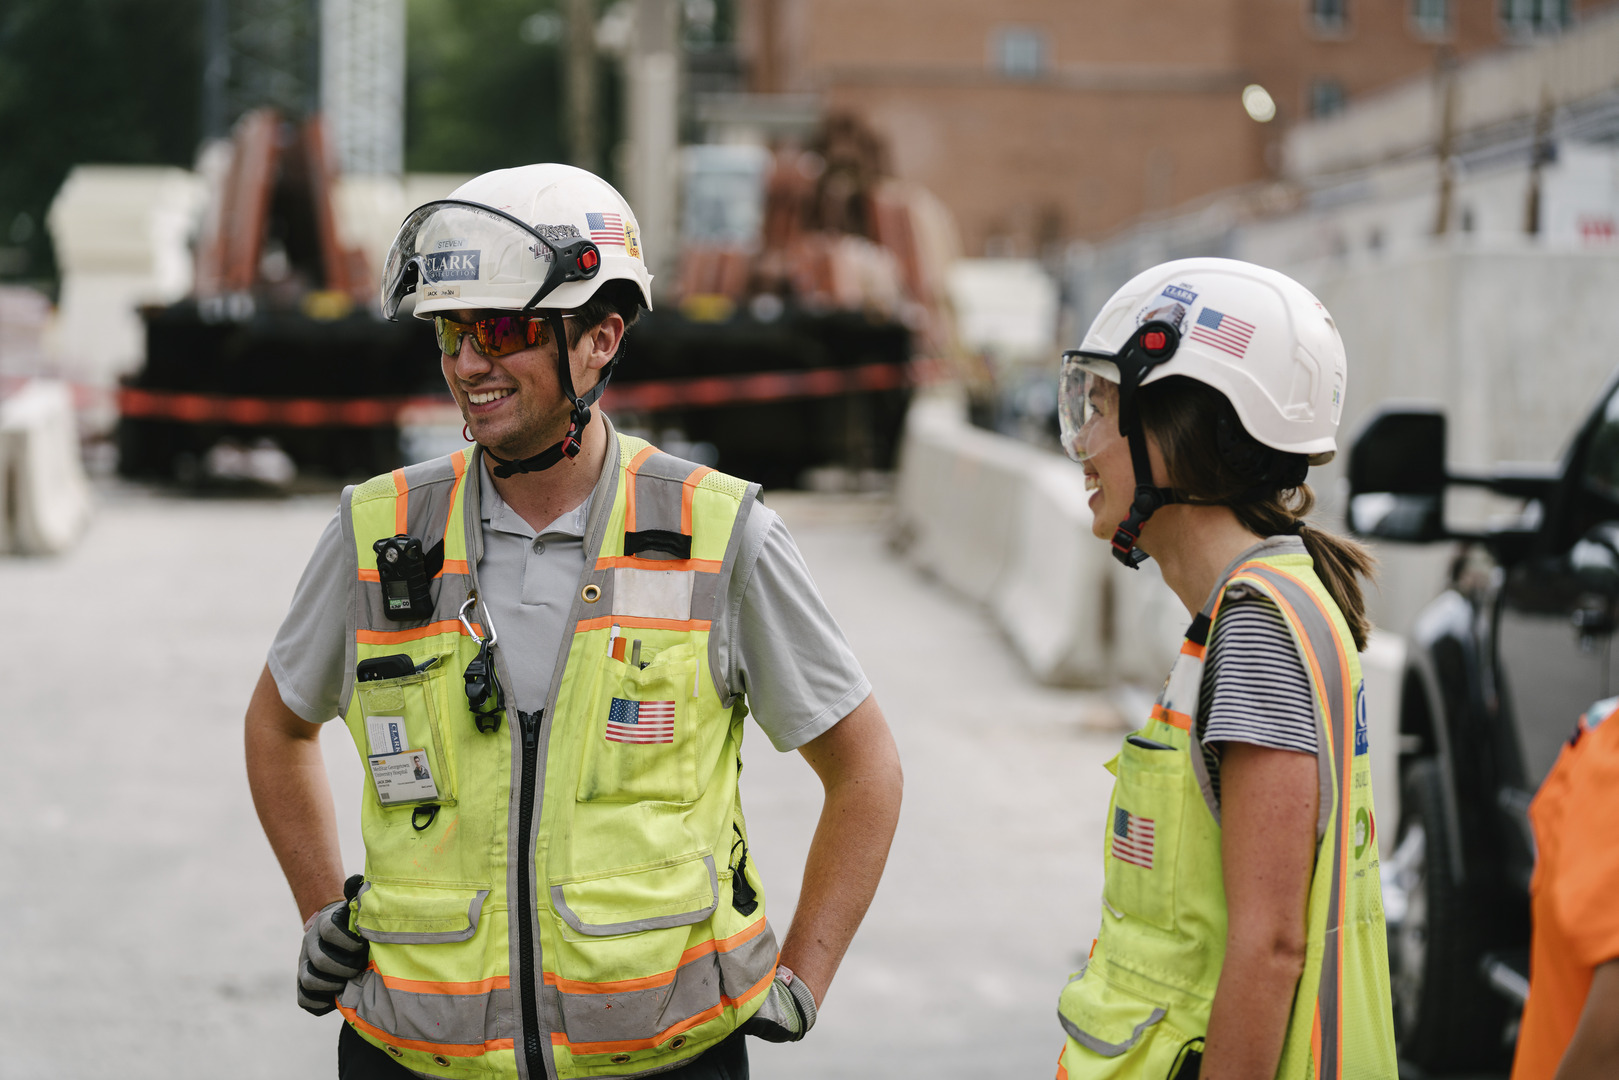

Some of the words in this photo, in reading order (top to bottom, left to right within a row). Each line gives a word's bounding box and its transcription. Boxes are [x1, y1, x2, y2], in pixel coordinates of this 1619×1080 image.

[437, 240, 463, 249] STEVEN
[1165, 286, 1194, 302] CLARK
[391, 723, 402, 752] CLARK
